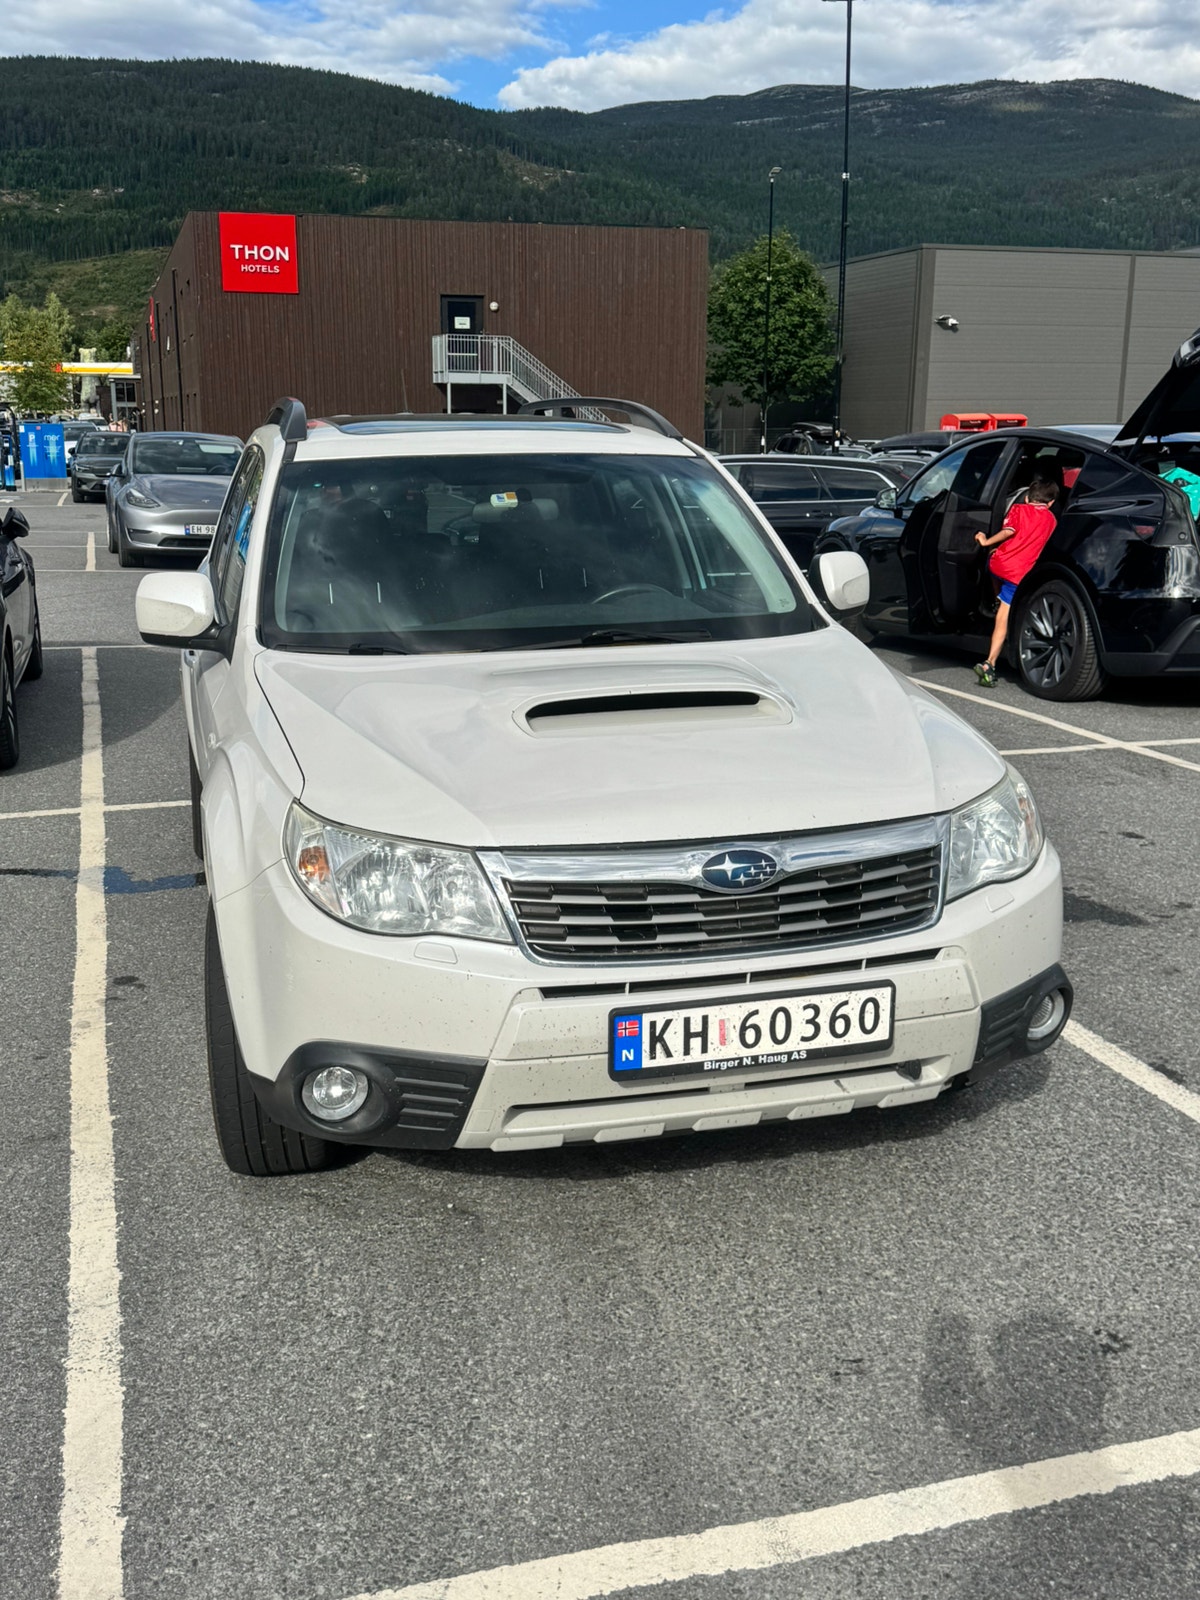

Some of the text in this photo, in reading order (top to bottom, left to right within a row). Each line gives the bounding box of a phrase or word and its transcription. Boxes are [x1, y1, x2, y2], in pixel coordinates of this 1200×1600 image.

[229, 244, 290, 262] THON
[240, 264, 280, 274] HOTELS
[191, 525, 202, 534] EH
[649, 996, 881, 1060] KH 60360
[621, 1048, 635, 1062] N
[703, 1049, 807, 1071] Birger N. Haug AS
